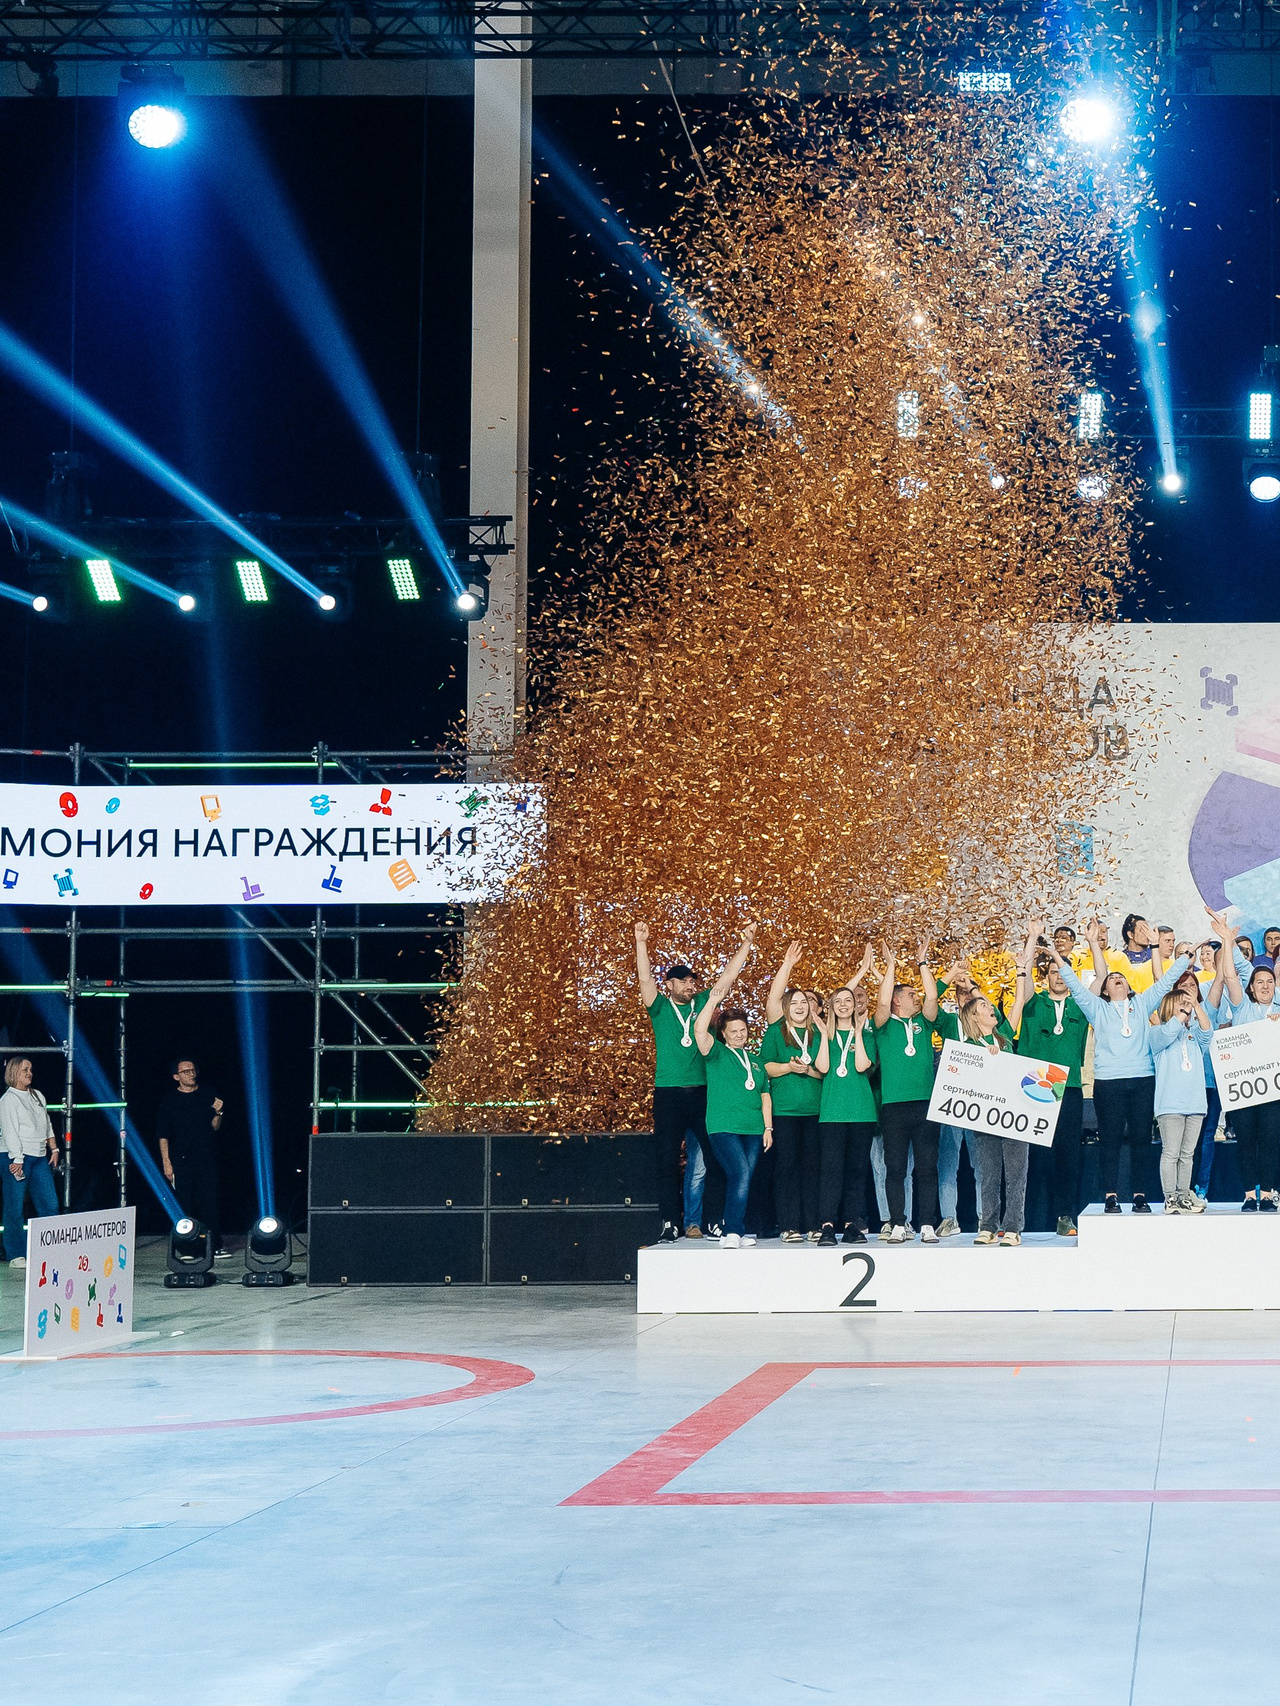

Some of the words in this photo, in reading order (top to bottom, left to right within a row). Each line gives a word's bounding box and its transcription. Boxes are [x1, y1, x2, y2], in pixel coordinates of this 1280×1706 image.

[1, 827, 157, 857] МОНИЯ
[174, 827, 477, 862] НАГРАЖДЕНИЯ
[1216, 1032, 1250, 1045] КОМАНДА
[1217, 1038, 1252, 1051] МАСТЕРОВ
[949, 1056, 984, 1069] МАСТЕРОВ
[950, 1049, 984, 1062] КОМАНДА
[1224, 1063, 1276, 1080] сертификат
[943, 1083, 994, 1102] сертификат
[995, 1096, 1006, 1104] на
[1228, 1077, 1268, 1102] 500
[938, 1097, 981, 1122] 400
[986, 1107, 1029, 1132] 000
[40, 1226, 83, 1247] КОМАНДА
[84, 1220, 127, 1242] МАСТЕРОВ
[839, 1251, 877, 1307] 2
